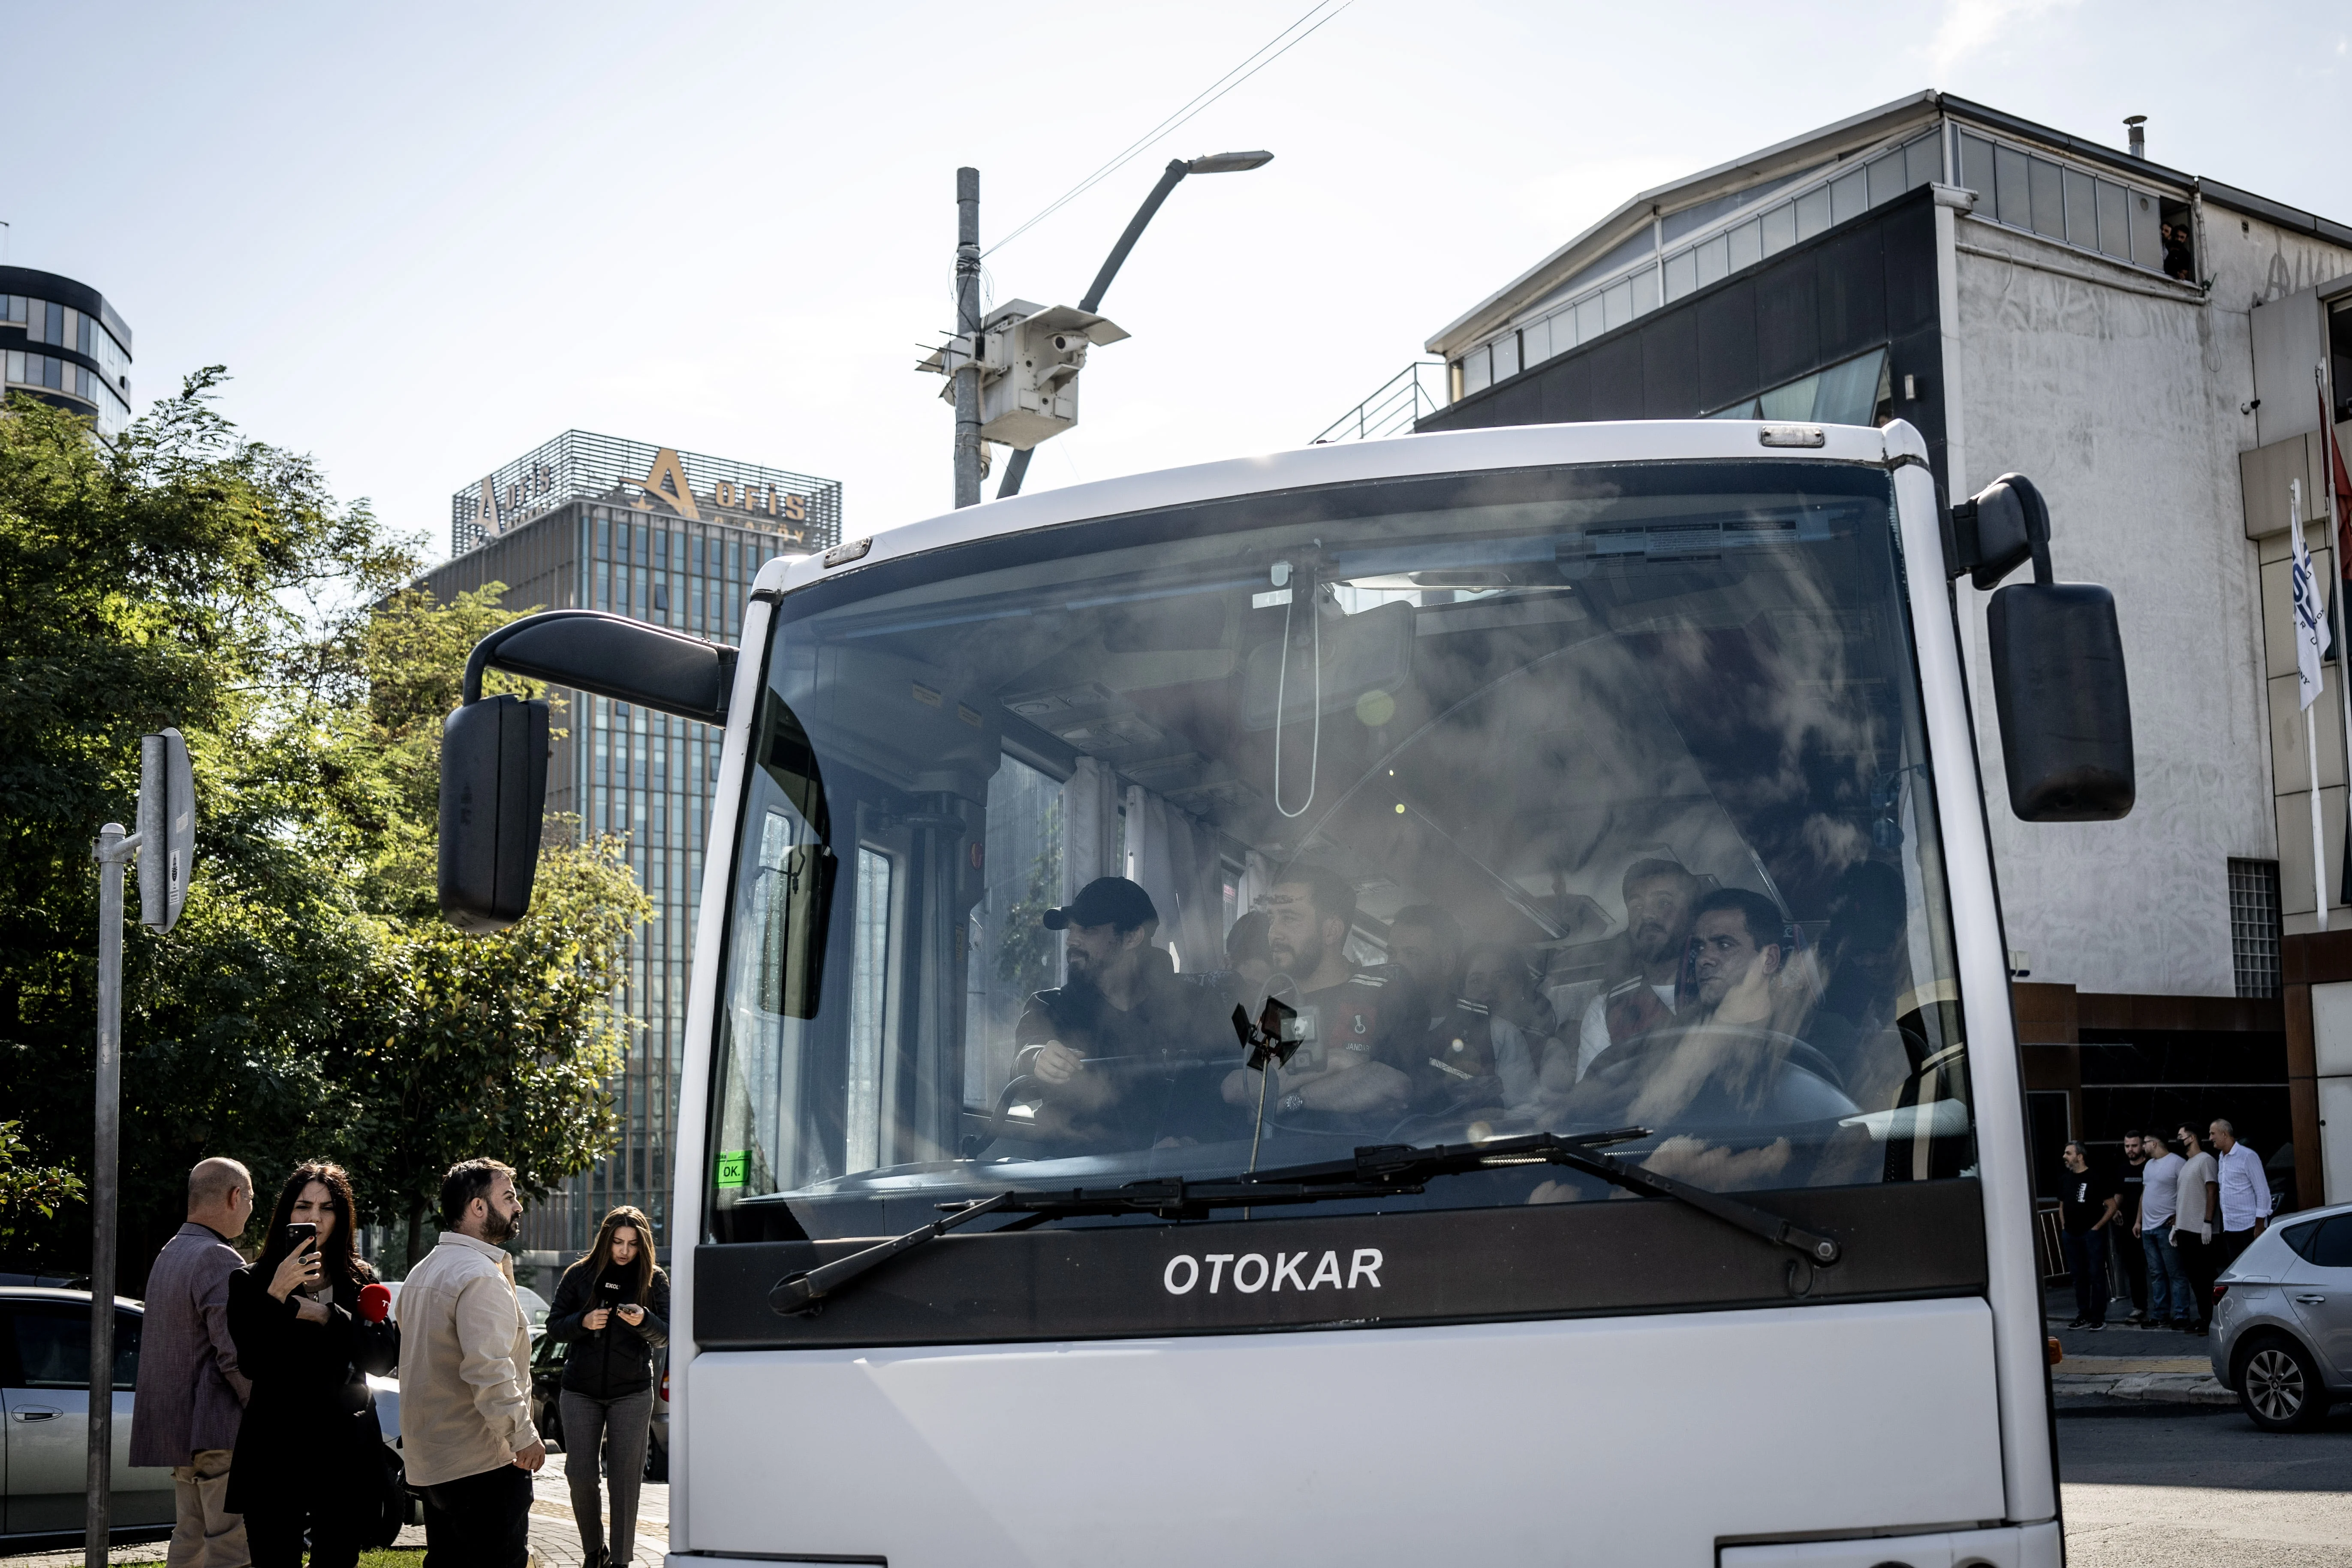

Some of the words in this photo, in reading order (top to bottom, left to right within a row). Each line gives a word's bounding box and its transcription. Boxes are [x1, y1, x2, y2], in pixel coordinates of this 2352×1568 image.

[716, 482, 805, 521] OFİS
[1346, 1043, 1371, 1052] JANDAR
[1164, 1248, 1383, 1295] OTOKAR
